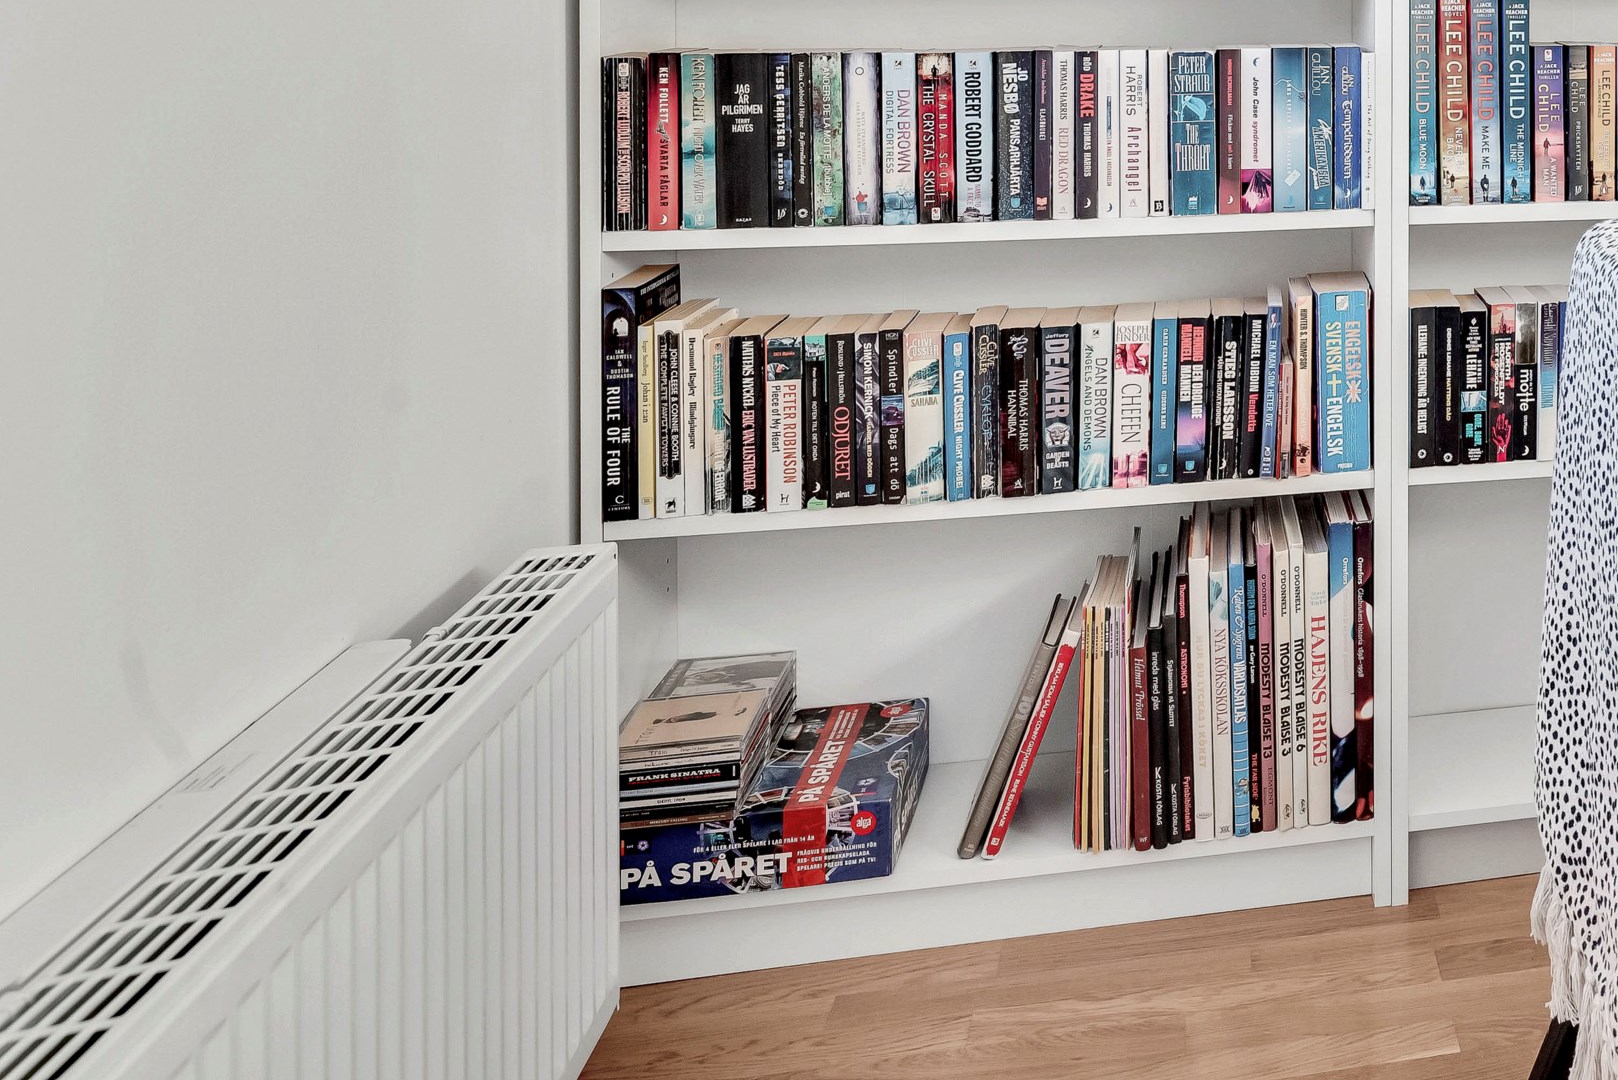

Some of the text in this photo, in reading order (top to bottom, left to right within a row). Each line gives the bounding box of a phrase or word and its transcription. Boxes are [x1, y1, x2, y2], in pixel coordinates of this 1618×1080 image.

[1002, 63, 1019, 114] NESBØ
[1175, 74, 1210, 91] STRAUB
[1178, 56, 1206, 74] PETER
[1415, 24, 1430, 113] LEE CHILD
[1476, 21, 1494, 170] LEE CHILD MAKE ME
[1509, 20, 1525, 119] LEE CHILD
[721, 104, 763, 115] PILGRIMEN
[922, 84, 936, 207] THE CRYSTAL SKULL
[965, 72, 982, 183] ROBERT GODDARD
[1009, 119, 1020, 196] PANSARHJÄRTA
[1174, 145, 1211, 171] THROAT
[1044, 339, 1070, 419] DEAVER
[1094, 357, 1109, 439] DAN BROWN
[1121, 383, 1141, 444] CHEFEN
[1325, 320, 1343, 457] SVENSK ENGELSK
[606, 386, 621, 488] RULE OF FOUR
[782, 384, 798, 484] PETER ROBINSON
[833, 406, 851, 481] ODJURET
[1214, 629, 1229, 736] NYA KÖKSSKOLAN
[1310, 615, 1327, 705] HAJENS
[1260, 642, 1272, 759] MODESTY BLAISE 13
[1312, 711, 1328, 767] RIKE
[628, 768, 721, 783] FRANK SINATRA
[856, 818, 872, 828] alga
[621, 852, 792, 889] PÅ SPÅRET
